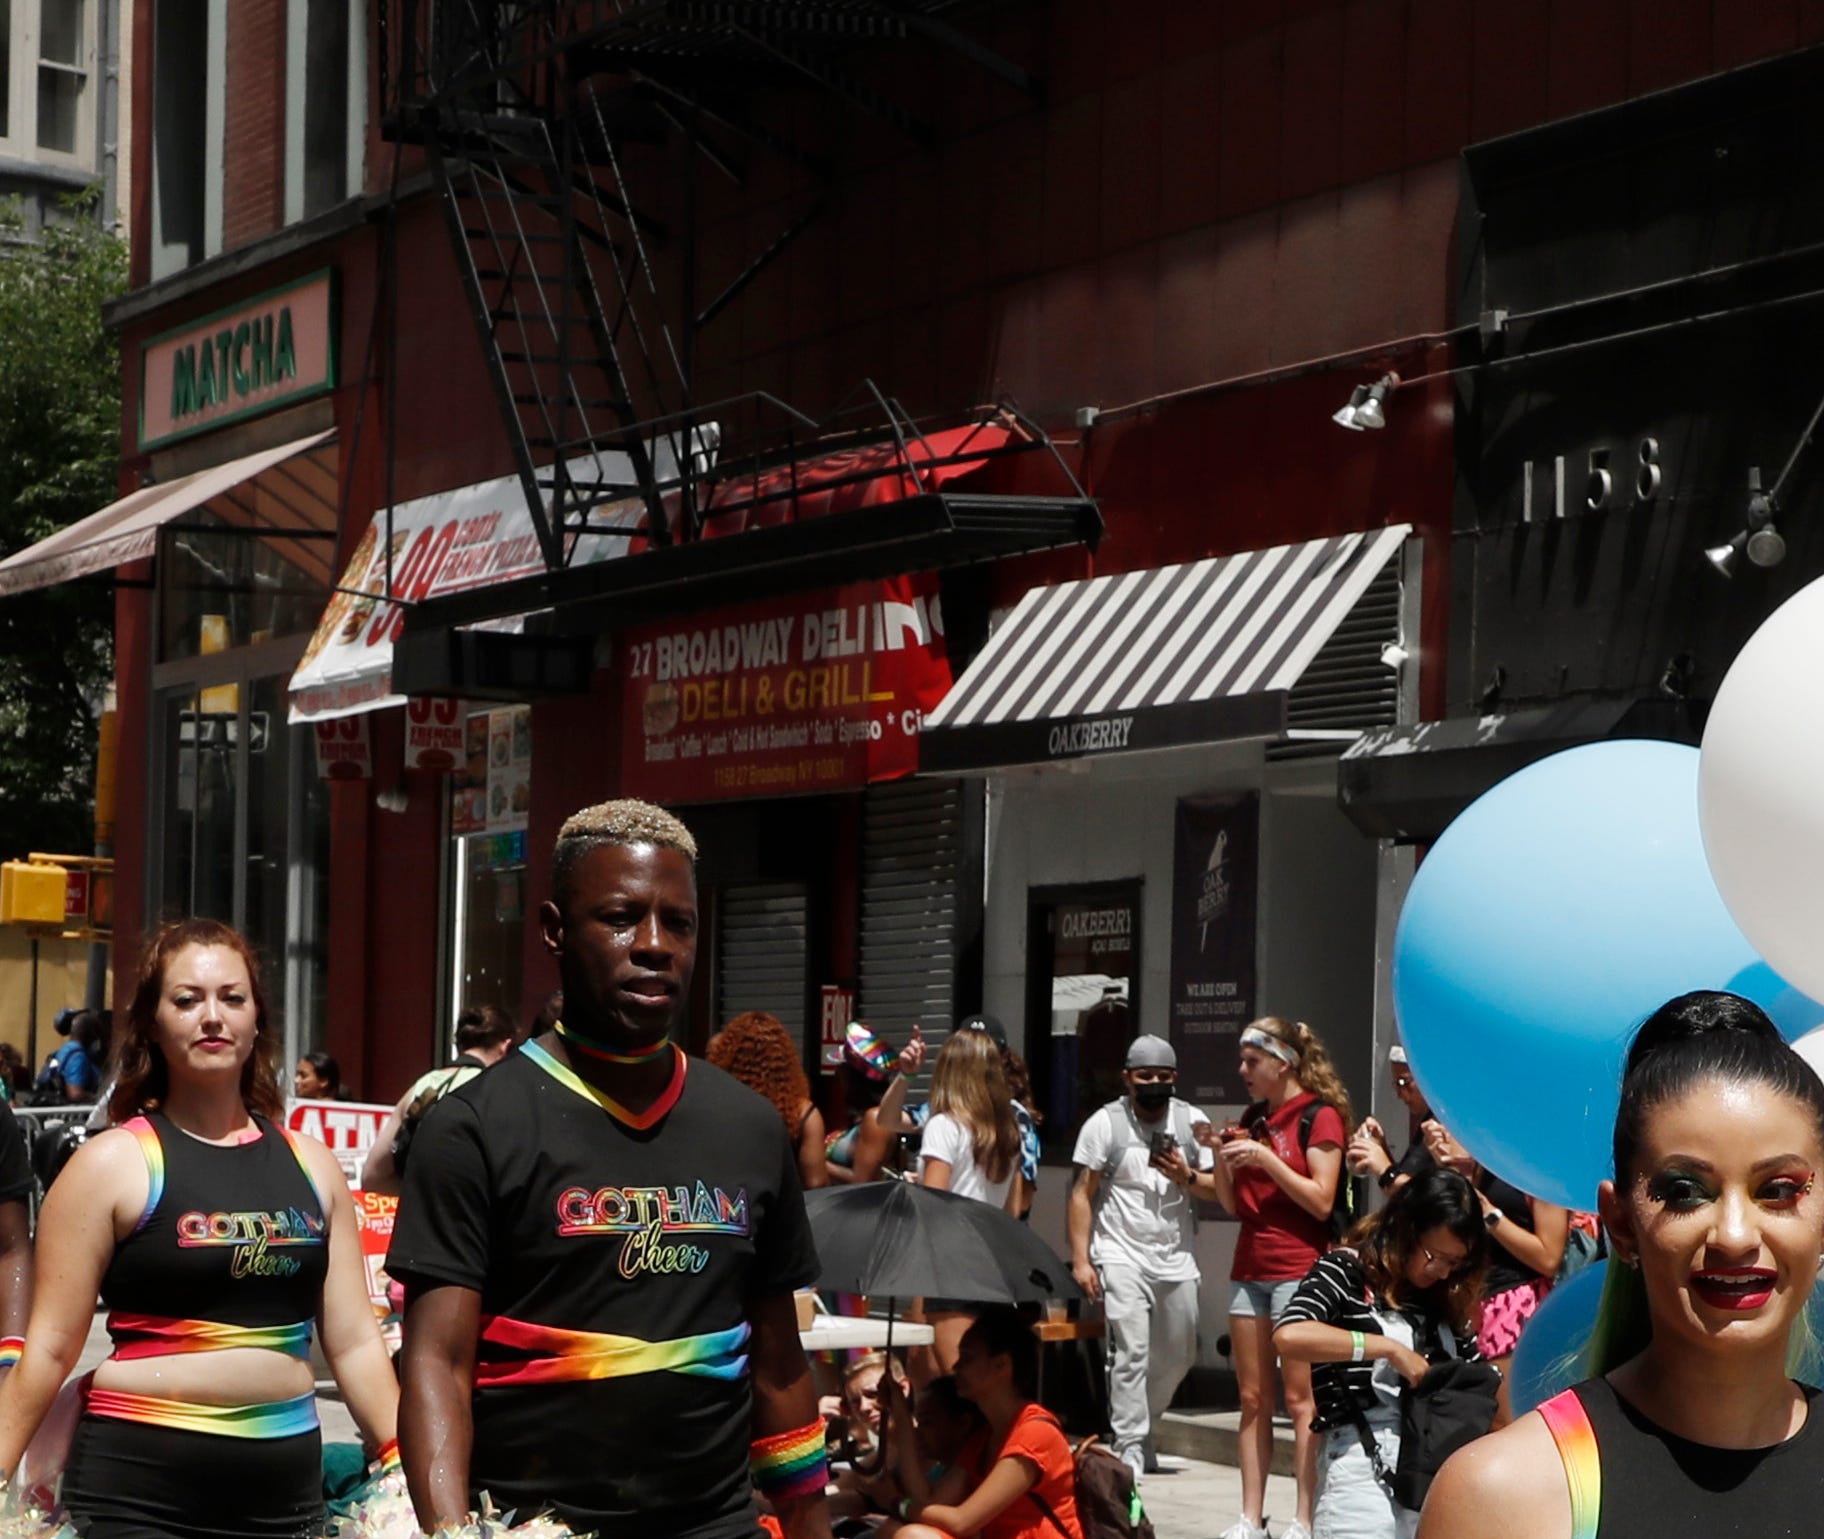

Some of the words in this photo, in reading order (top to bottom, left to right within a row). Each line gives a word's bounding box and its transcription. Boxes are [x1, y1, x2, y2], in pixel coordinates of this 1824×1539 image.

[171, 306, 296, 420] MATCHA
[1523, 437, 1662, 523] 1158
[629, 641, 653, 679] 27
[656, 615, 795, 681] BROADWAY
[801, 603, 867, 661] DELI
[682, 676, 748, 722] DELI
[755, 674, 775, 715] &
[783, 660, 895, 712] GRILL
[1048, 716, 1134, 755] OAKBERRY
[177, 1206, 327, 1240] GOTHAM
[557, 1179, 749, 1226] GOTHAM
[230, 1236, 301, 1279] Cheer
[619, 1220, 709, 1279] Cheer
